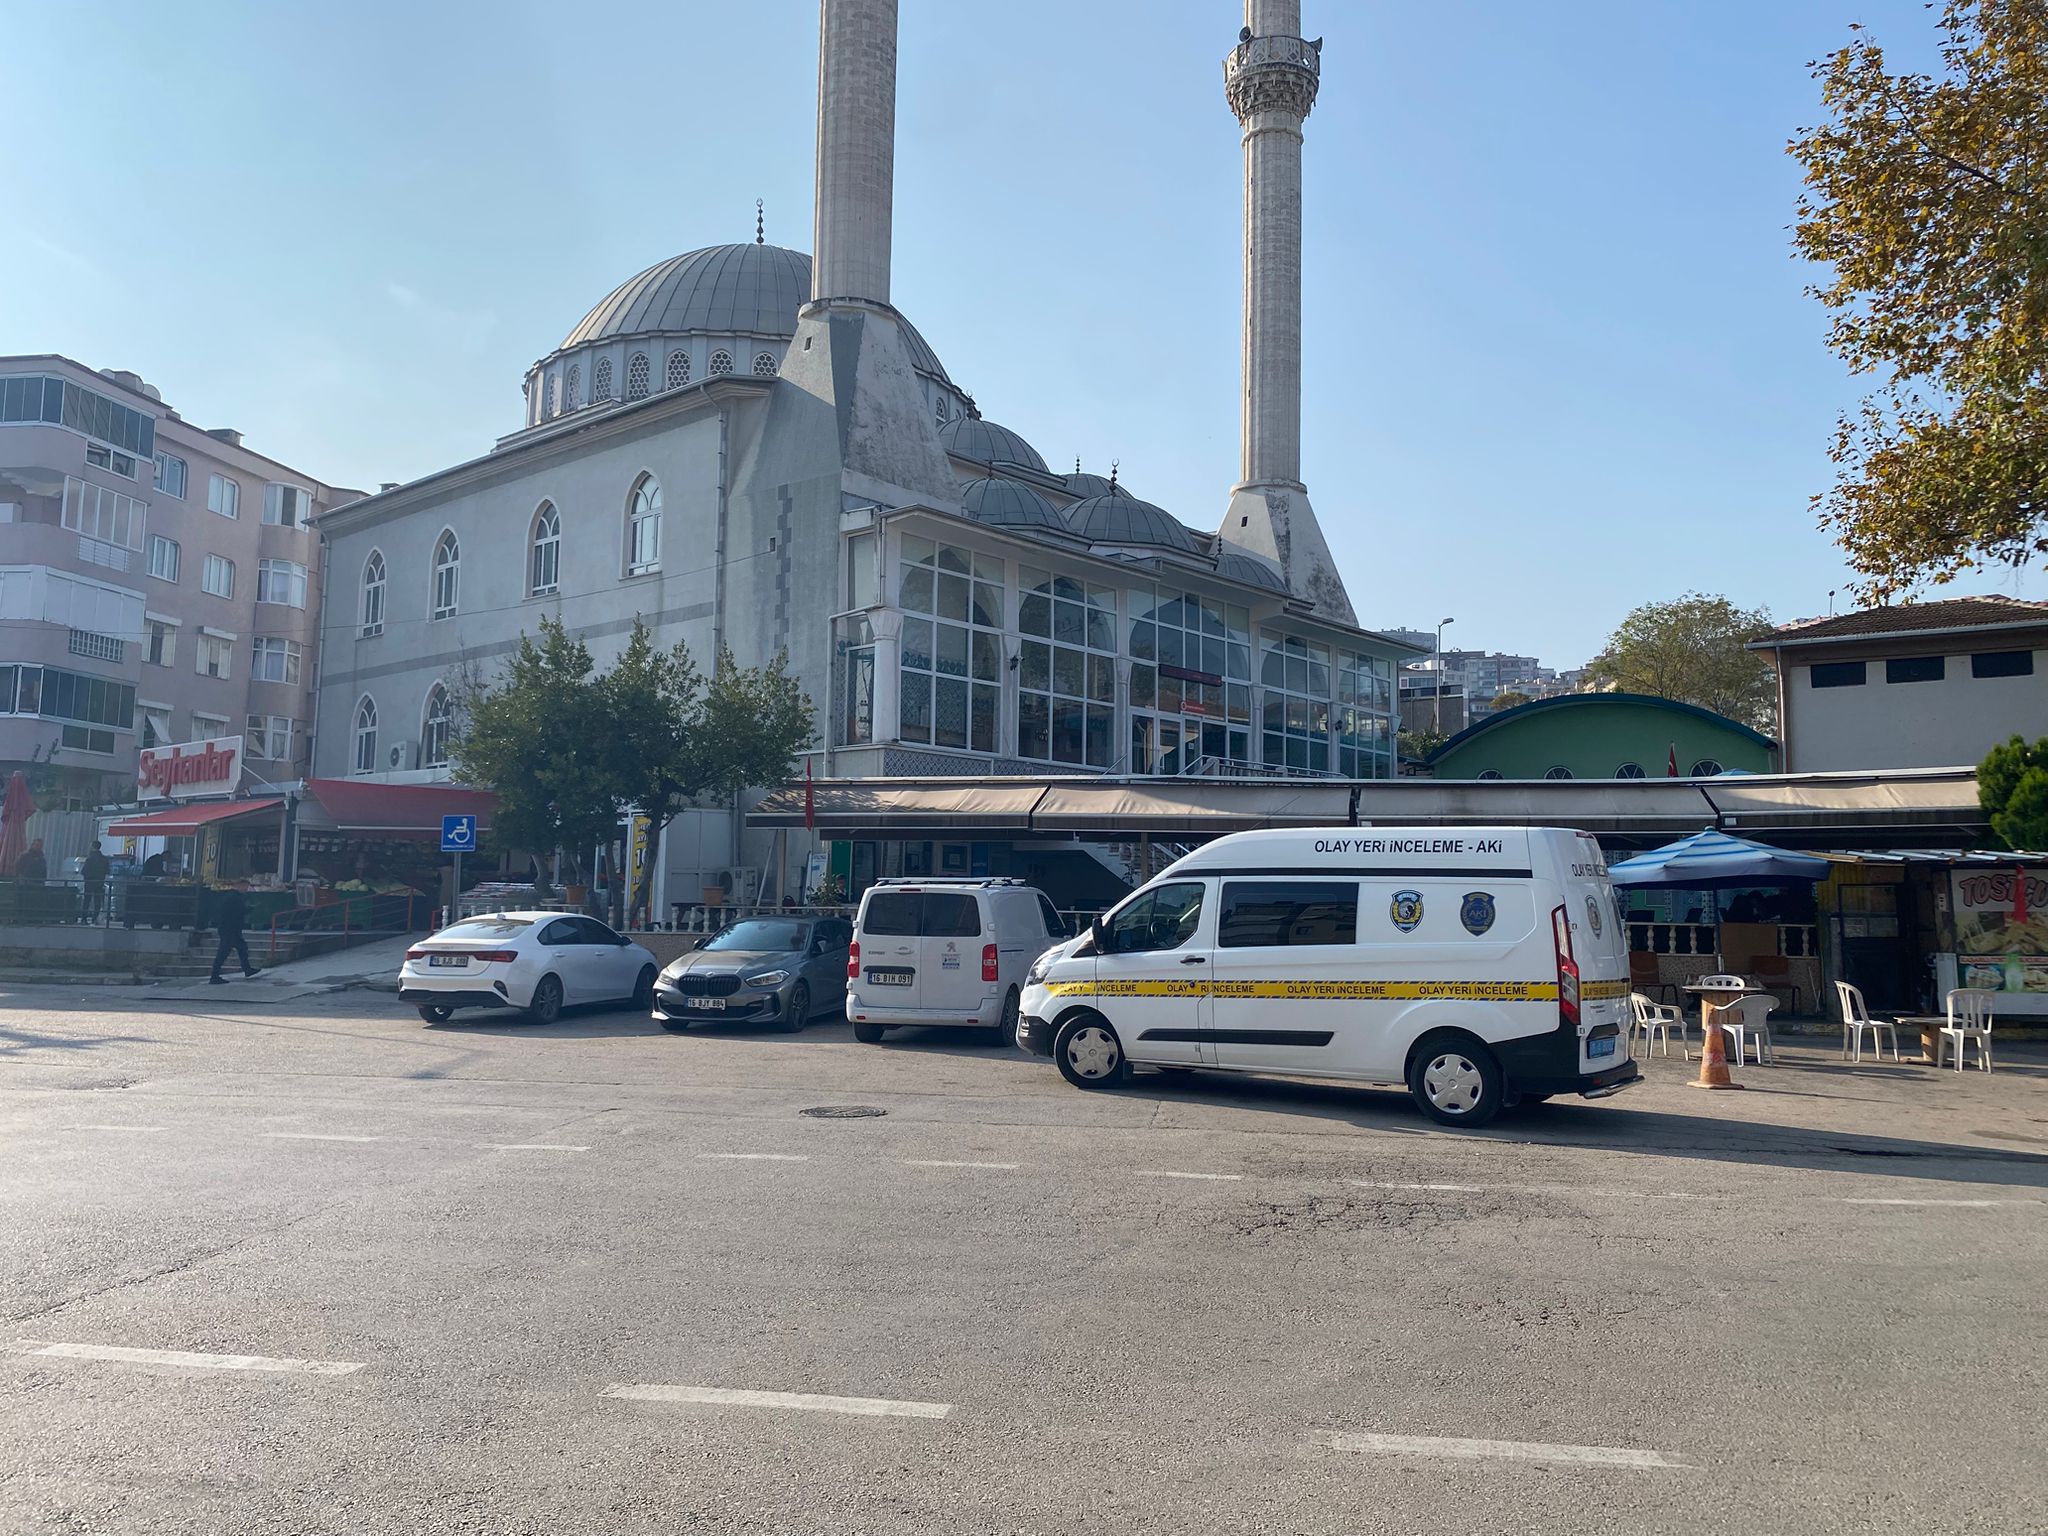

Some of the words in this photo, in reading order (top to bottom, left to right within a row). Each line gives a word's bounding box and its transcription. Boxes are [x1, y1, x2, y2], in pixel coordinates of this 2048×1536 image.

[138, 742, 236, 796] Seyhanlar
[1314, 840, 1351, 853] OLAY
[873, 974, 881, 982] 16
[883, 975, 896, 983] BIH
[898, 975, 911, 984] 091
[1167, 984, 1188, 992] OLAY
[1287, 985, 1311, 994] OLAY
[1419, 986, 1446, 995] OLAY
